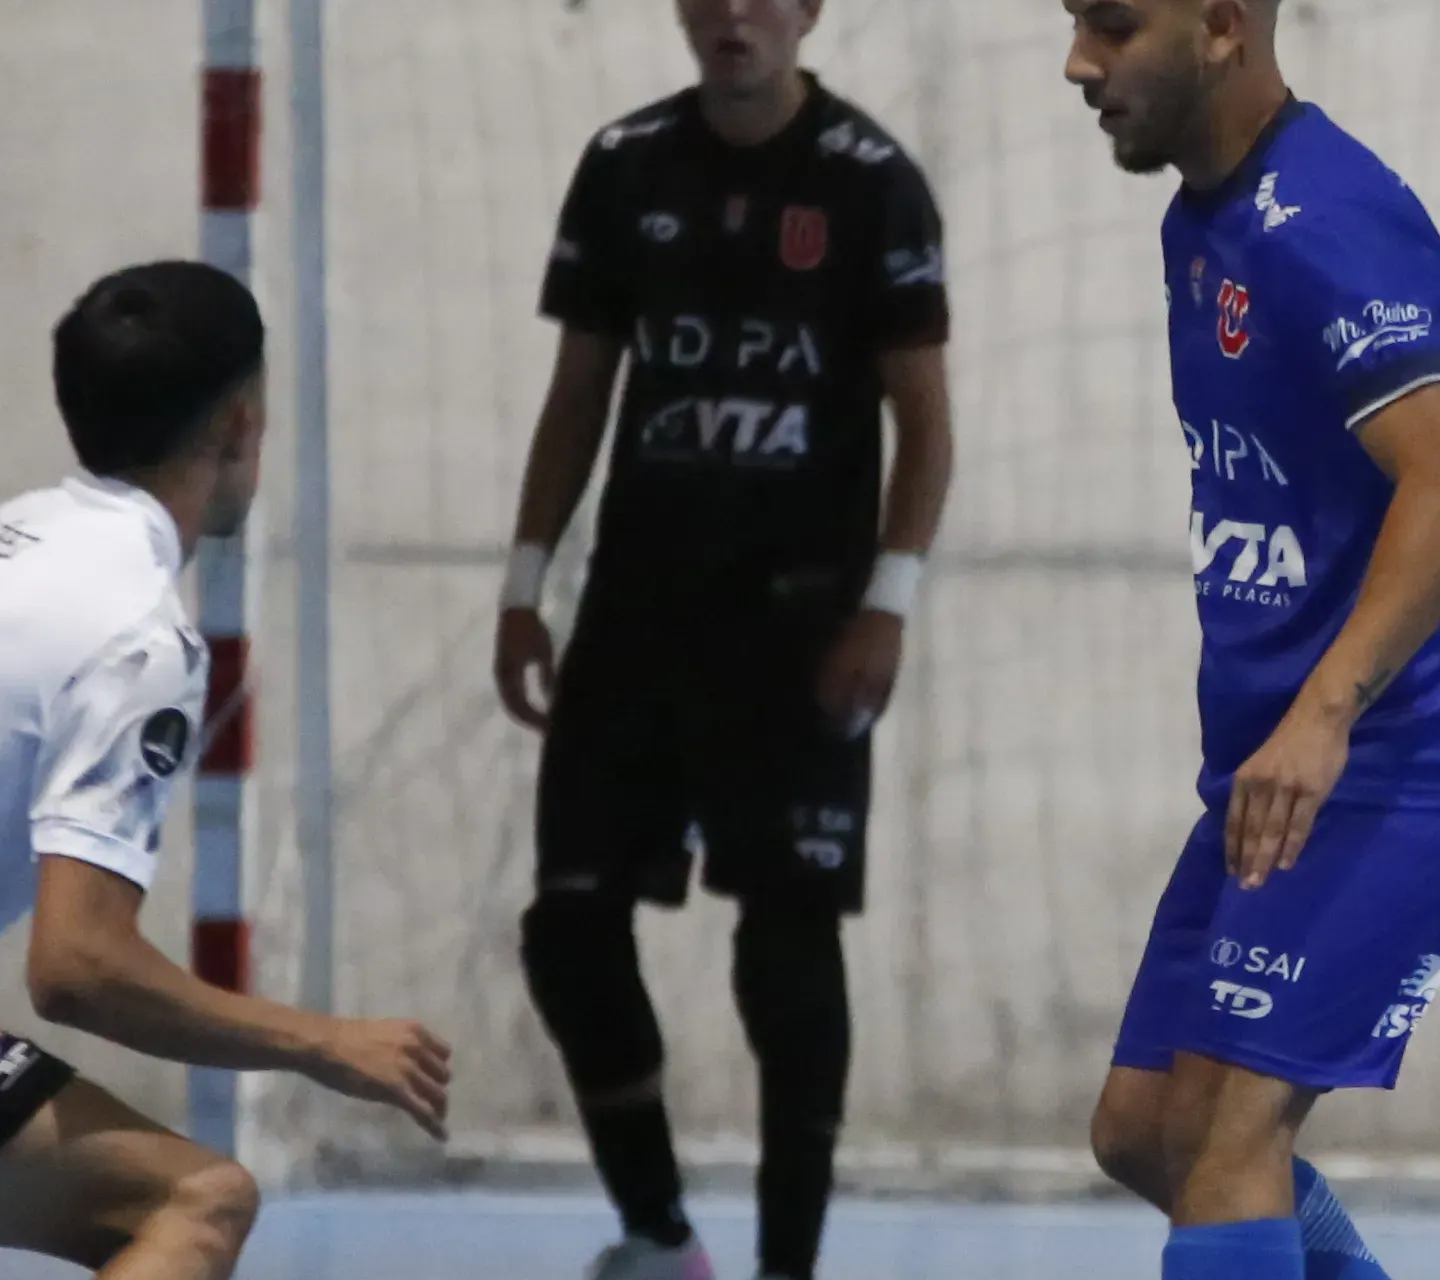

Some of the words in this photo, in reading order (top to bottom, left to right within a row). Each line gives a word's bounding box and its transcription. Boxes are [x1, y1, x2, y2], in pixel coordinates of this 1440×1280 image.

[1322, 317, 1367, 353] Mr.
[1222, 582, 1293, 609] PLAGAS
[1244, 946, 1306, 983] SAI
